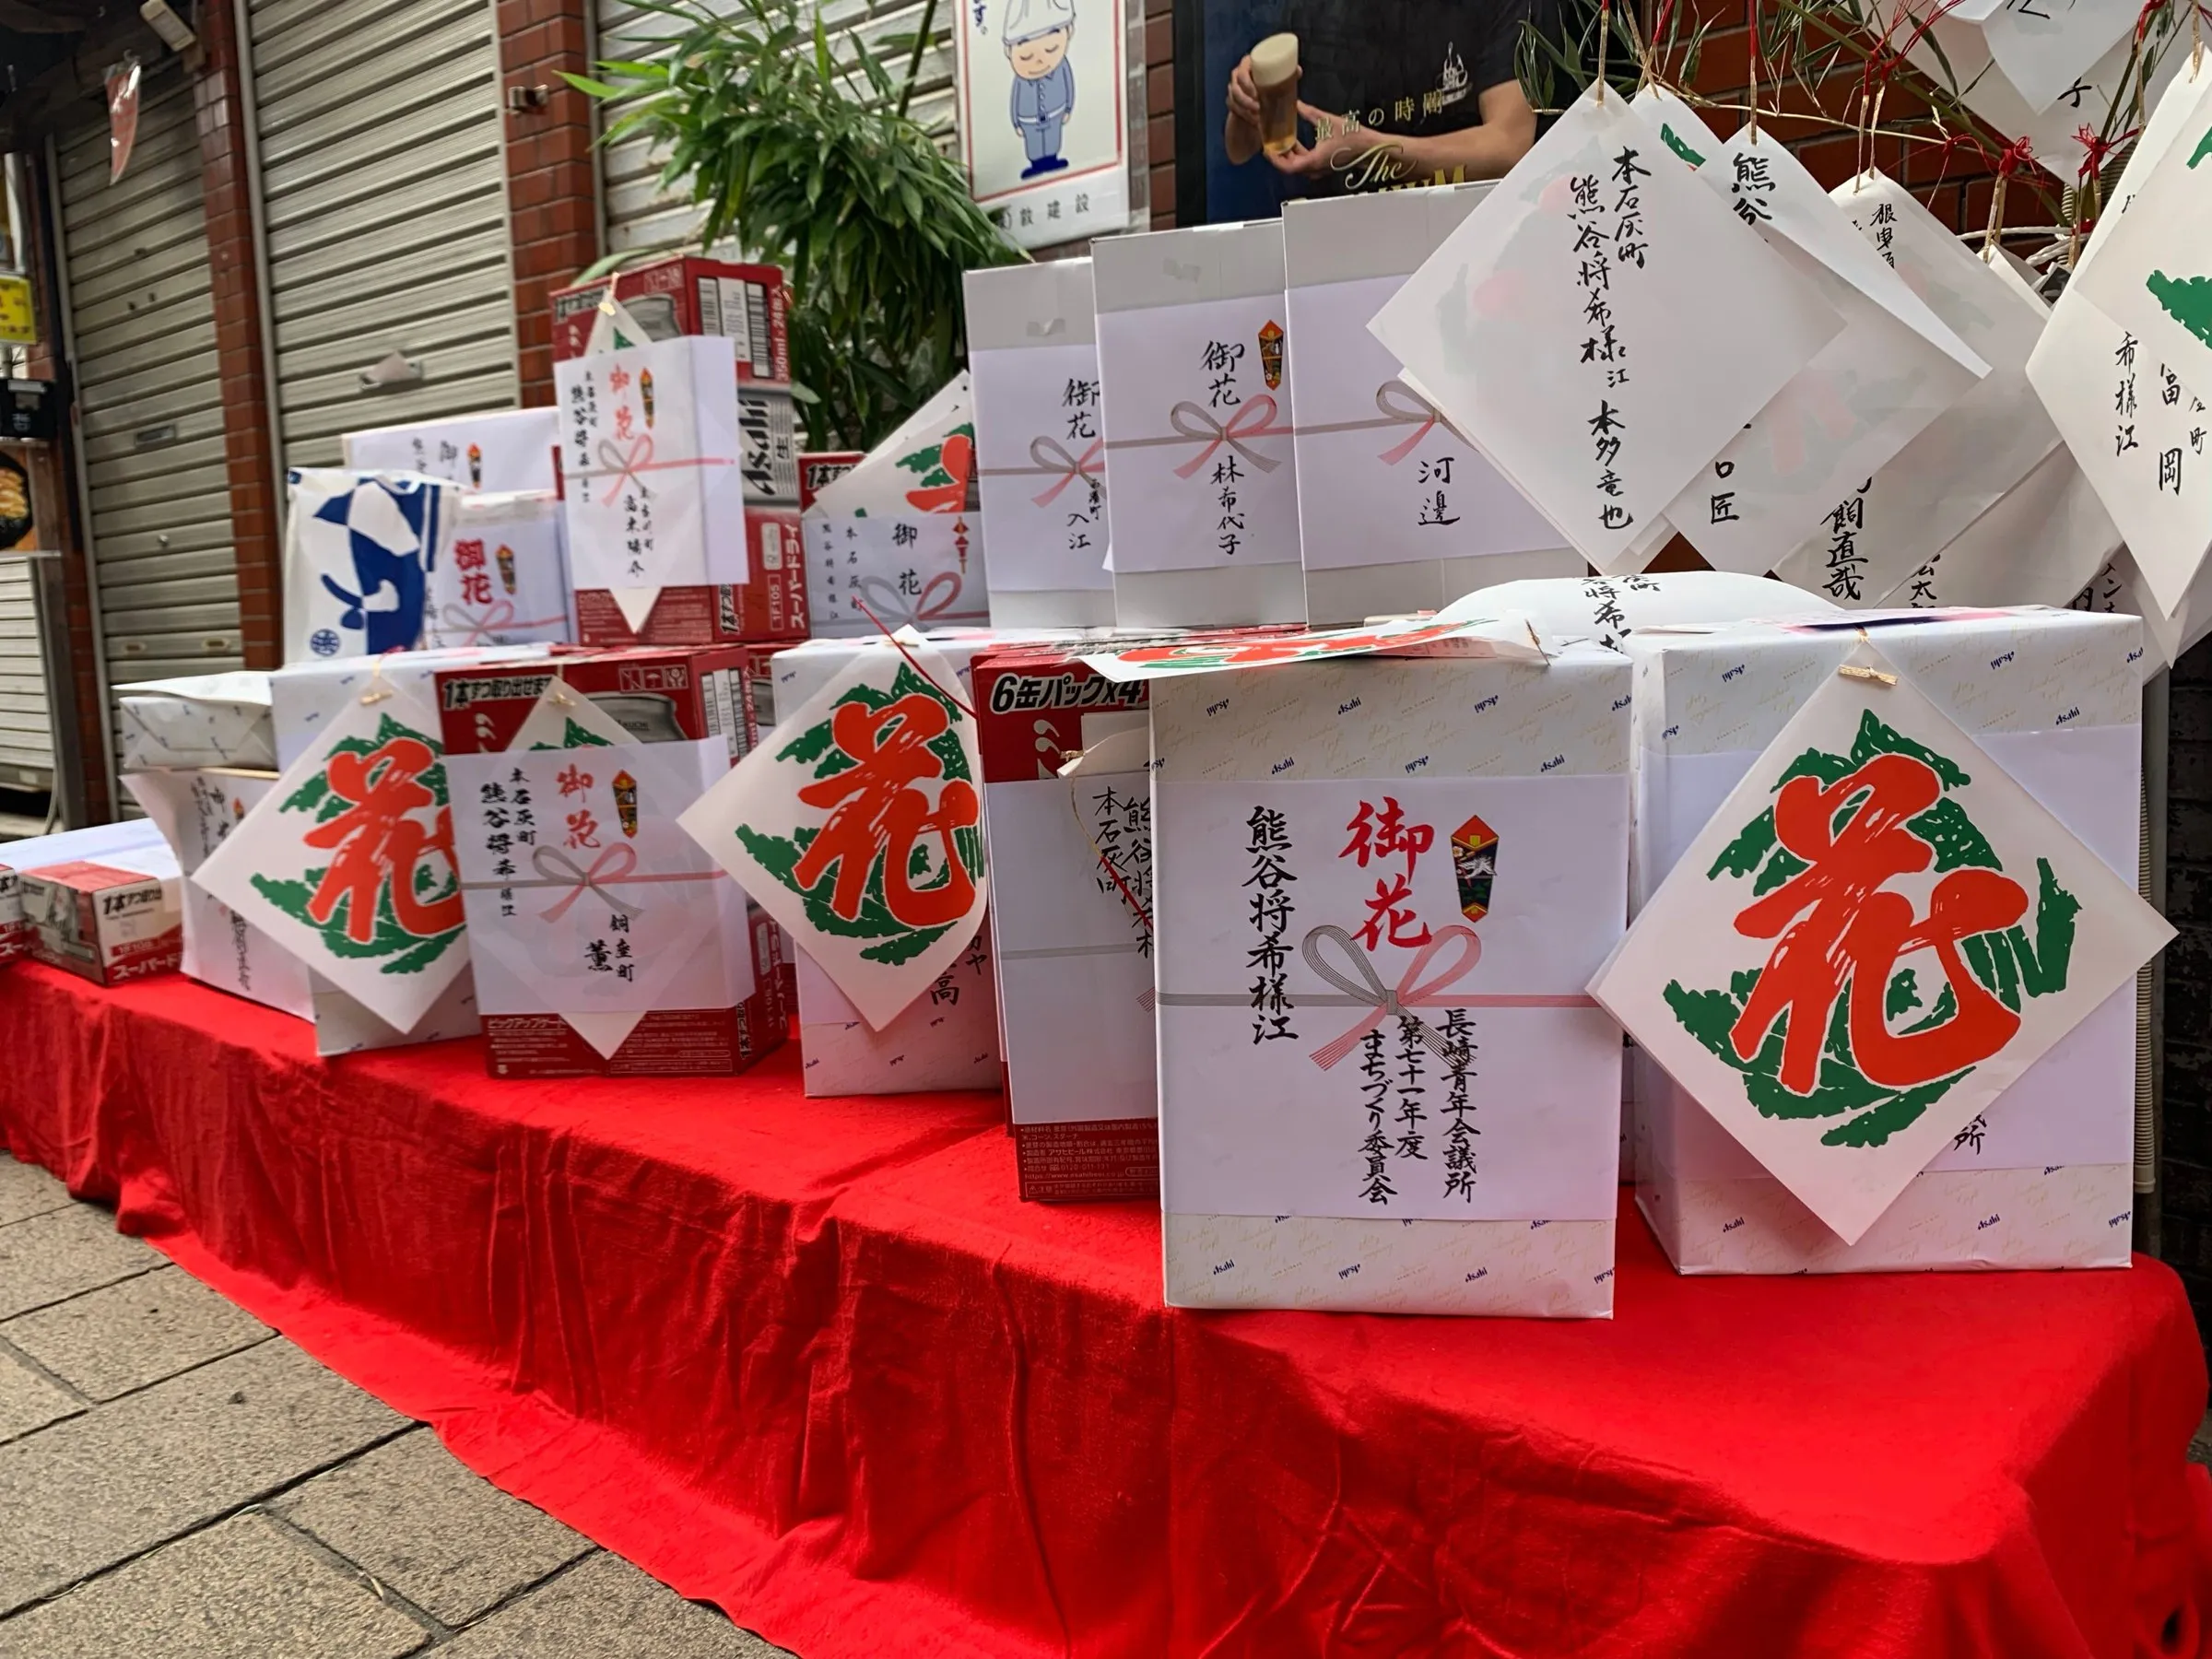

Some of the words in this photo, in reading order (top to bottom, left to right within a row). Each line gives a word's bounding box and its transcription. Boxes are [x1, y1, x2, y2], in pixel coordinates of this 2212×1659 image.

[1330, 142, 1418, 190] The
[1200, 340, 1245, 408] 御花
[1062, 378, 1100, 441] 御花
[739, 396, 777, 496] Asahi
[1587, 400, 1634, 530] 本多竜也
[1211, 455, 1245, 556] 林希代子
[1067, 512, 1091, 550] 入江
[1820, 477, 1870, 601] 飼直哉
[891, 523, 923, 596] 御花
[1908, 553, 1937, 609] 公太
[1722, 664, 1746, 683] Asahi
[1990, 650, 2015, 670] Asahi
[1206, 698, 1230, 717] Asahi
[1337, 696, 1362, 715] Asahi
[1475, 694, 1499, 714] Asahi
[2054, 706, 2080, 726] Asahi
[1271, 757, 1295, 775] Asahi
[1405, 755, 1430, 774] Asahi
[1540, 754, 1566, 773] Asahi
[509, 767, 537, 846] 本石灰町
[556, 763, 602, 850] 御花
[1092, 786, 1128, 905] 本石灰町
[1339, 795, 1435, 952] 御花
[1241, 806, 1300, 1044] 熊谷将希様江
[1394, 1015, 1429, 1160] 第七十一年度
[1435, 1007, 1482, 1204] 長崎青年会議所
[1358, 1029, 1398, 1205] まちづくり委員会
[1954, 1114, 1988, 1156] 所
[1722, 1217, 1746, 1233] Asahi
[1977, 1213, 2001, 1230] Asahi
[2108, 1210, 2131, 1229] Asahi
[1213, 1259, 1236, 1276] Asahi
[1339, 1263, 1362, 1280] Asahi
[1465, 1266, 1488, 1283] Asahi
